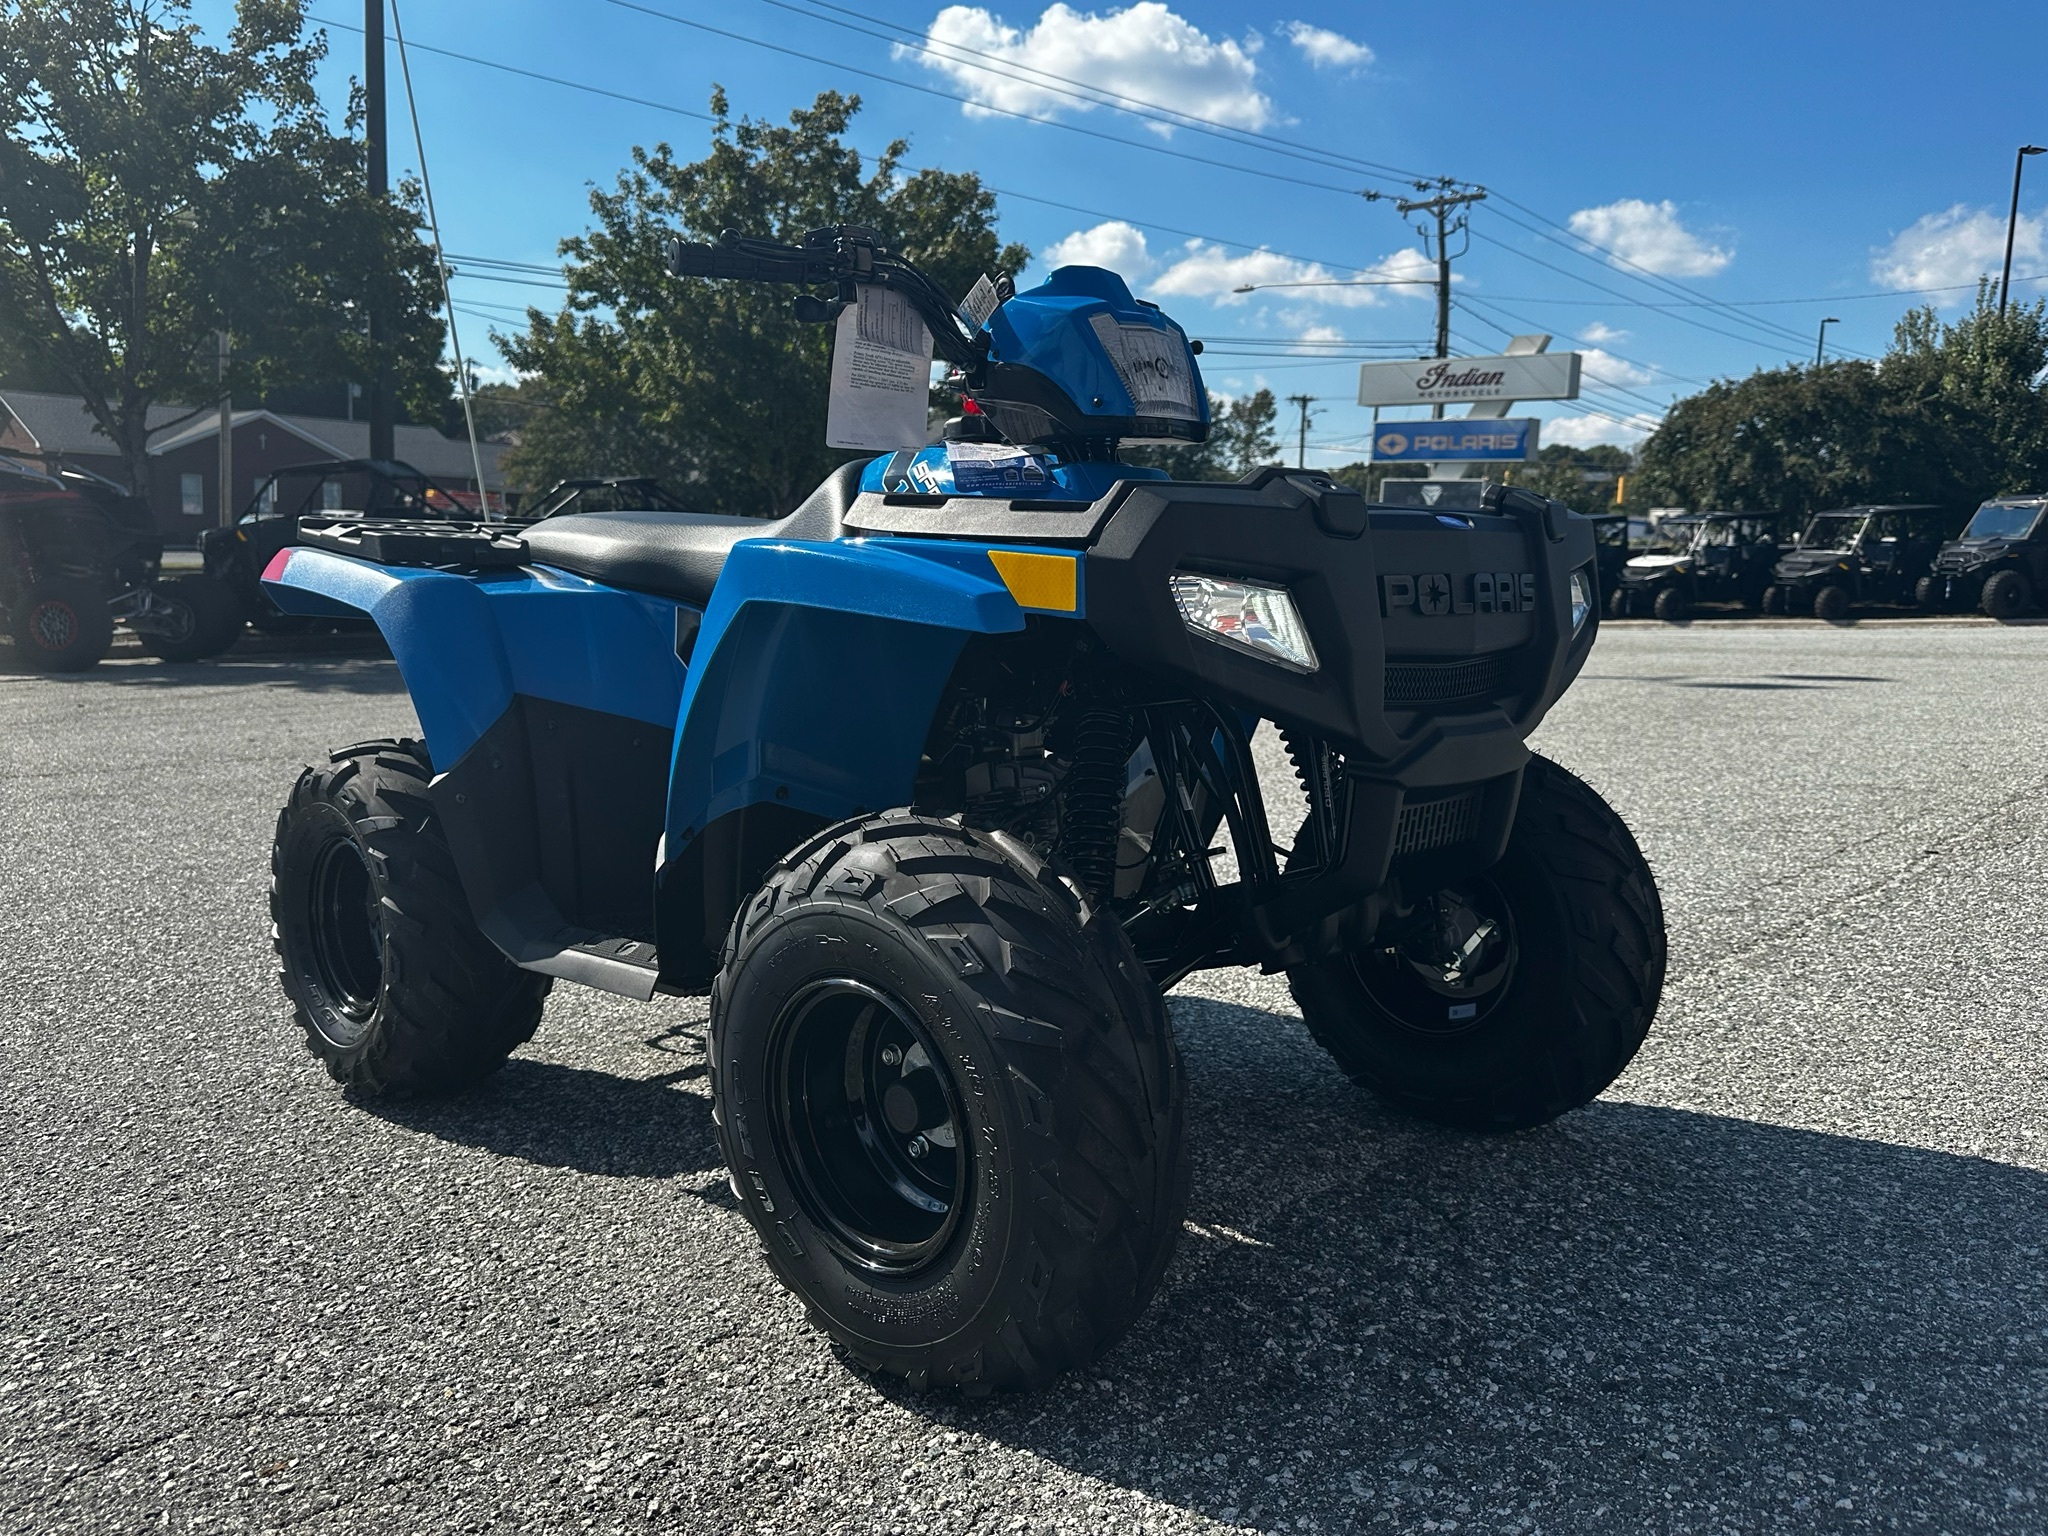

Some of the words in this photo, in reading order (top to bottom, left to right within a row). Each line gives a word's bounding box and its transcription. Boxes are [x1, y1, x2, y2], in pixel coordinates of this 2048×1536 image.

[1416, 363, 1504, 389] Indian
[1418, 388, 1500, 398] MOTORCYCLE
[1414, 433, 1517, 450] POLARIS
[1379, 573, 1535, 617] POLARIS
